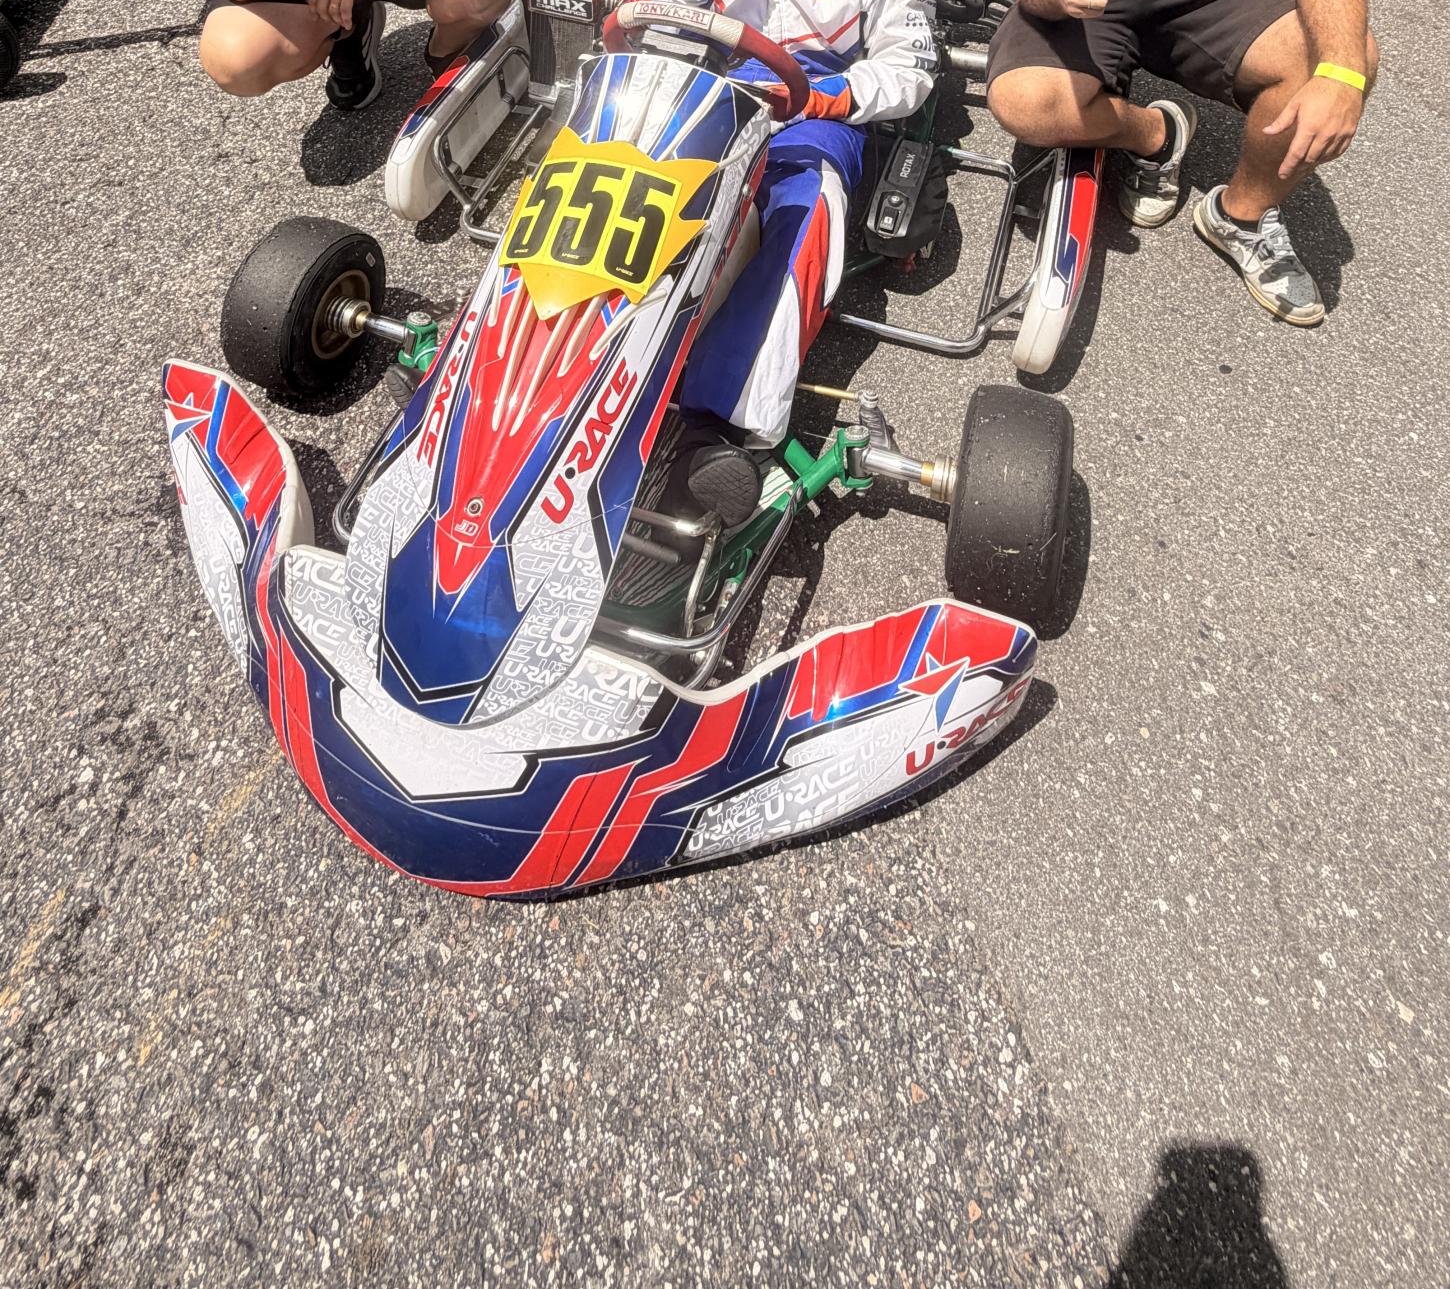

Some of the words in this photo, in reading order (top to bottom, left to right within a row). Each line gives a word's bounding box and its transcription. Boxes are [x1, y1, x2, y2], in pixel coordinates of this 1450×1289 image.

[535, 2, 588, 18] CHALLENGE
[899, 152, 916, 179] ROTAX
[506, 161, 677, 285] 555
